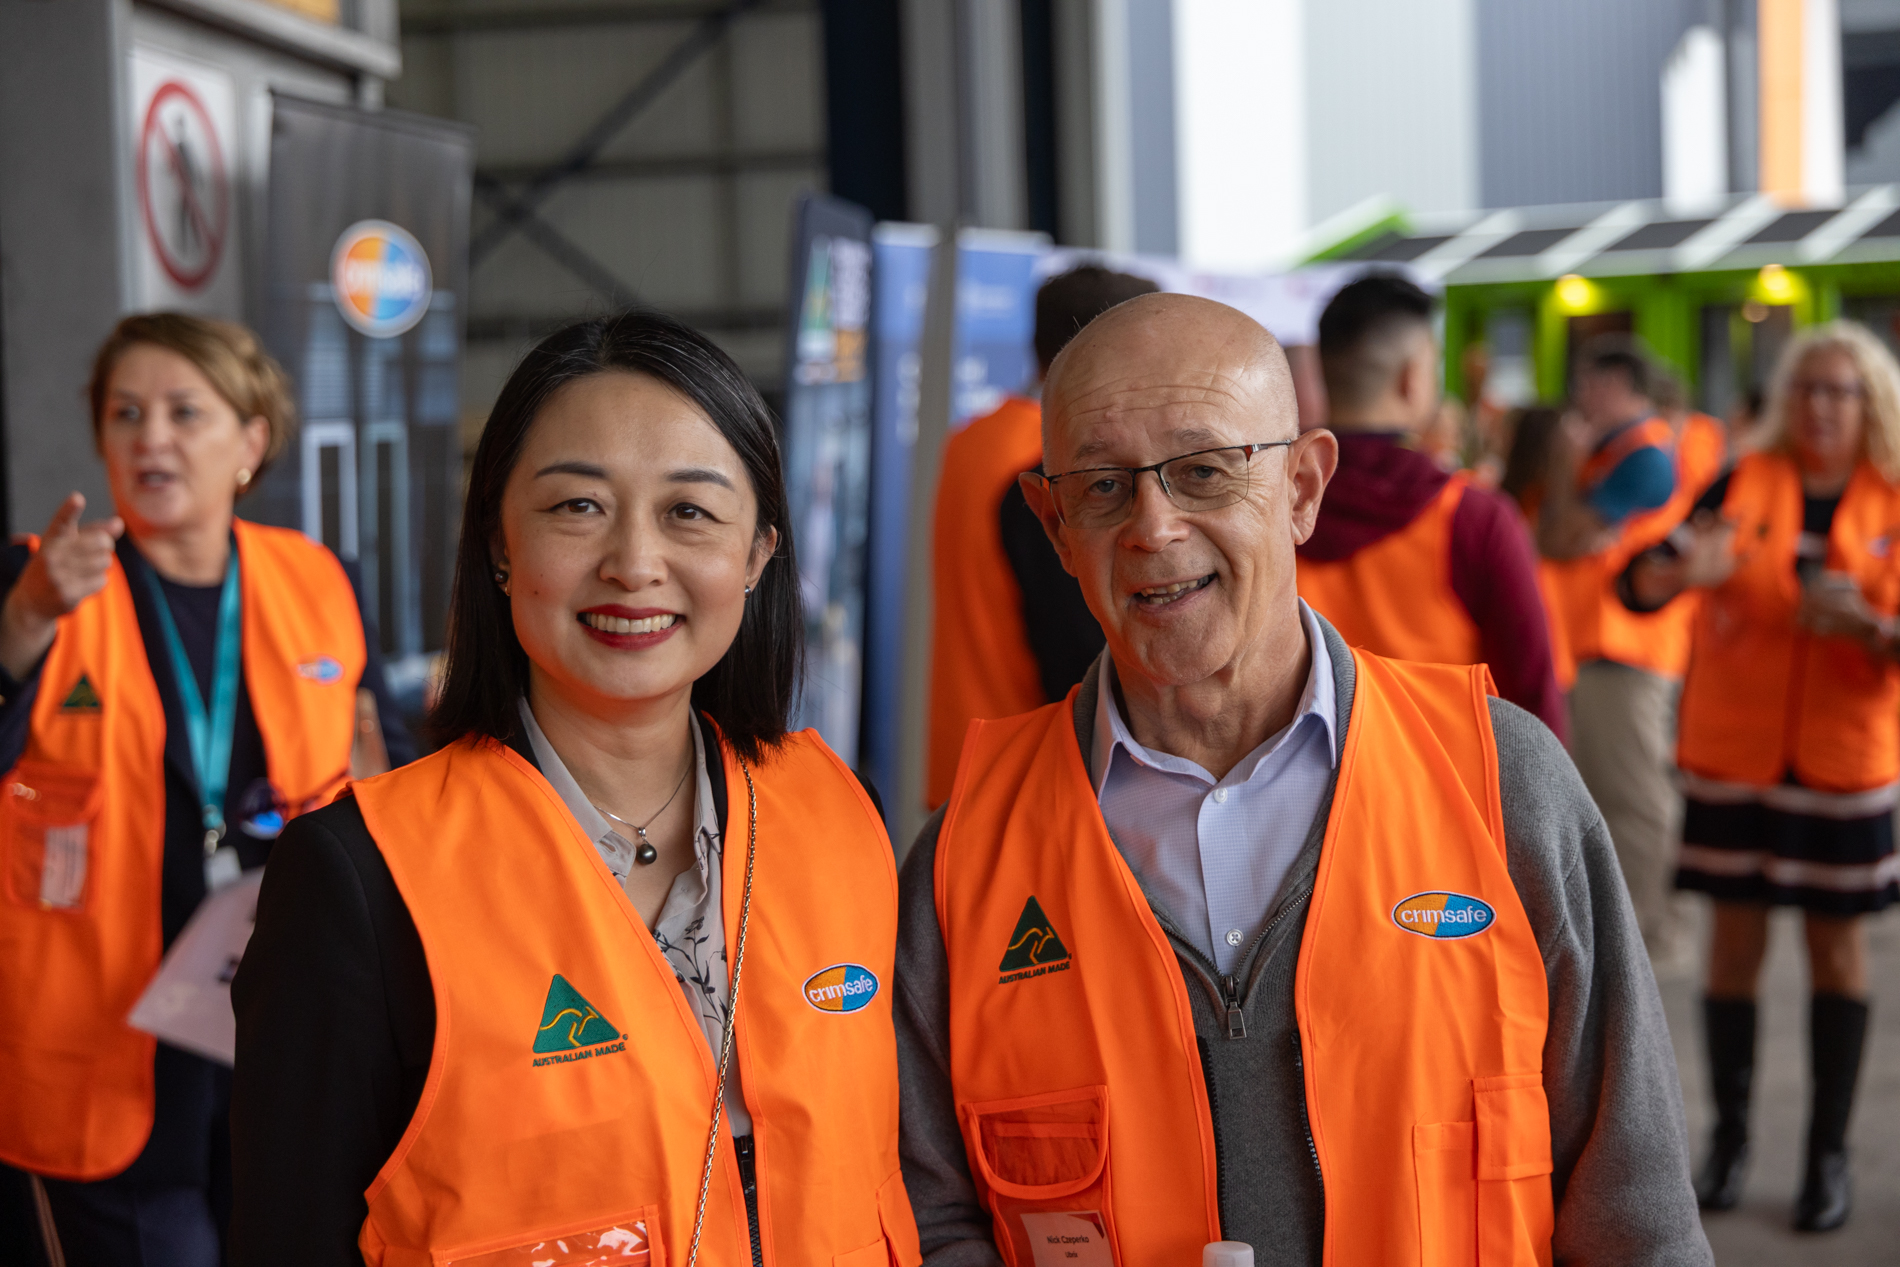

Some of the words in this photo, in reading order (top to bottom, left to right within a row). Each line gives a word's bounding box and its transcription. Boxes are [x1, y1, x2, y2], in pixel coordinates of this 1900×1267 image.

[1400, 905, 1487, 924] crimsafe
[998, 967, 1047, 985] AUSTRALIAN
[1047, 961, 1071, 974] MADE
[808, 975, 873, 1002] crimsafe
[532, 1050, 593, 1067] AUSTRALIAN
[595, 1042, 626, 1057] MADE
[1046, 1235, 1060, 1244] Nick
